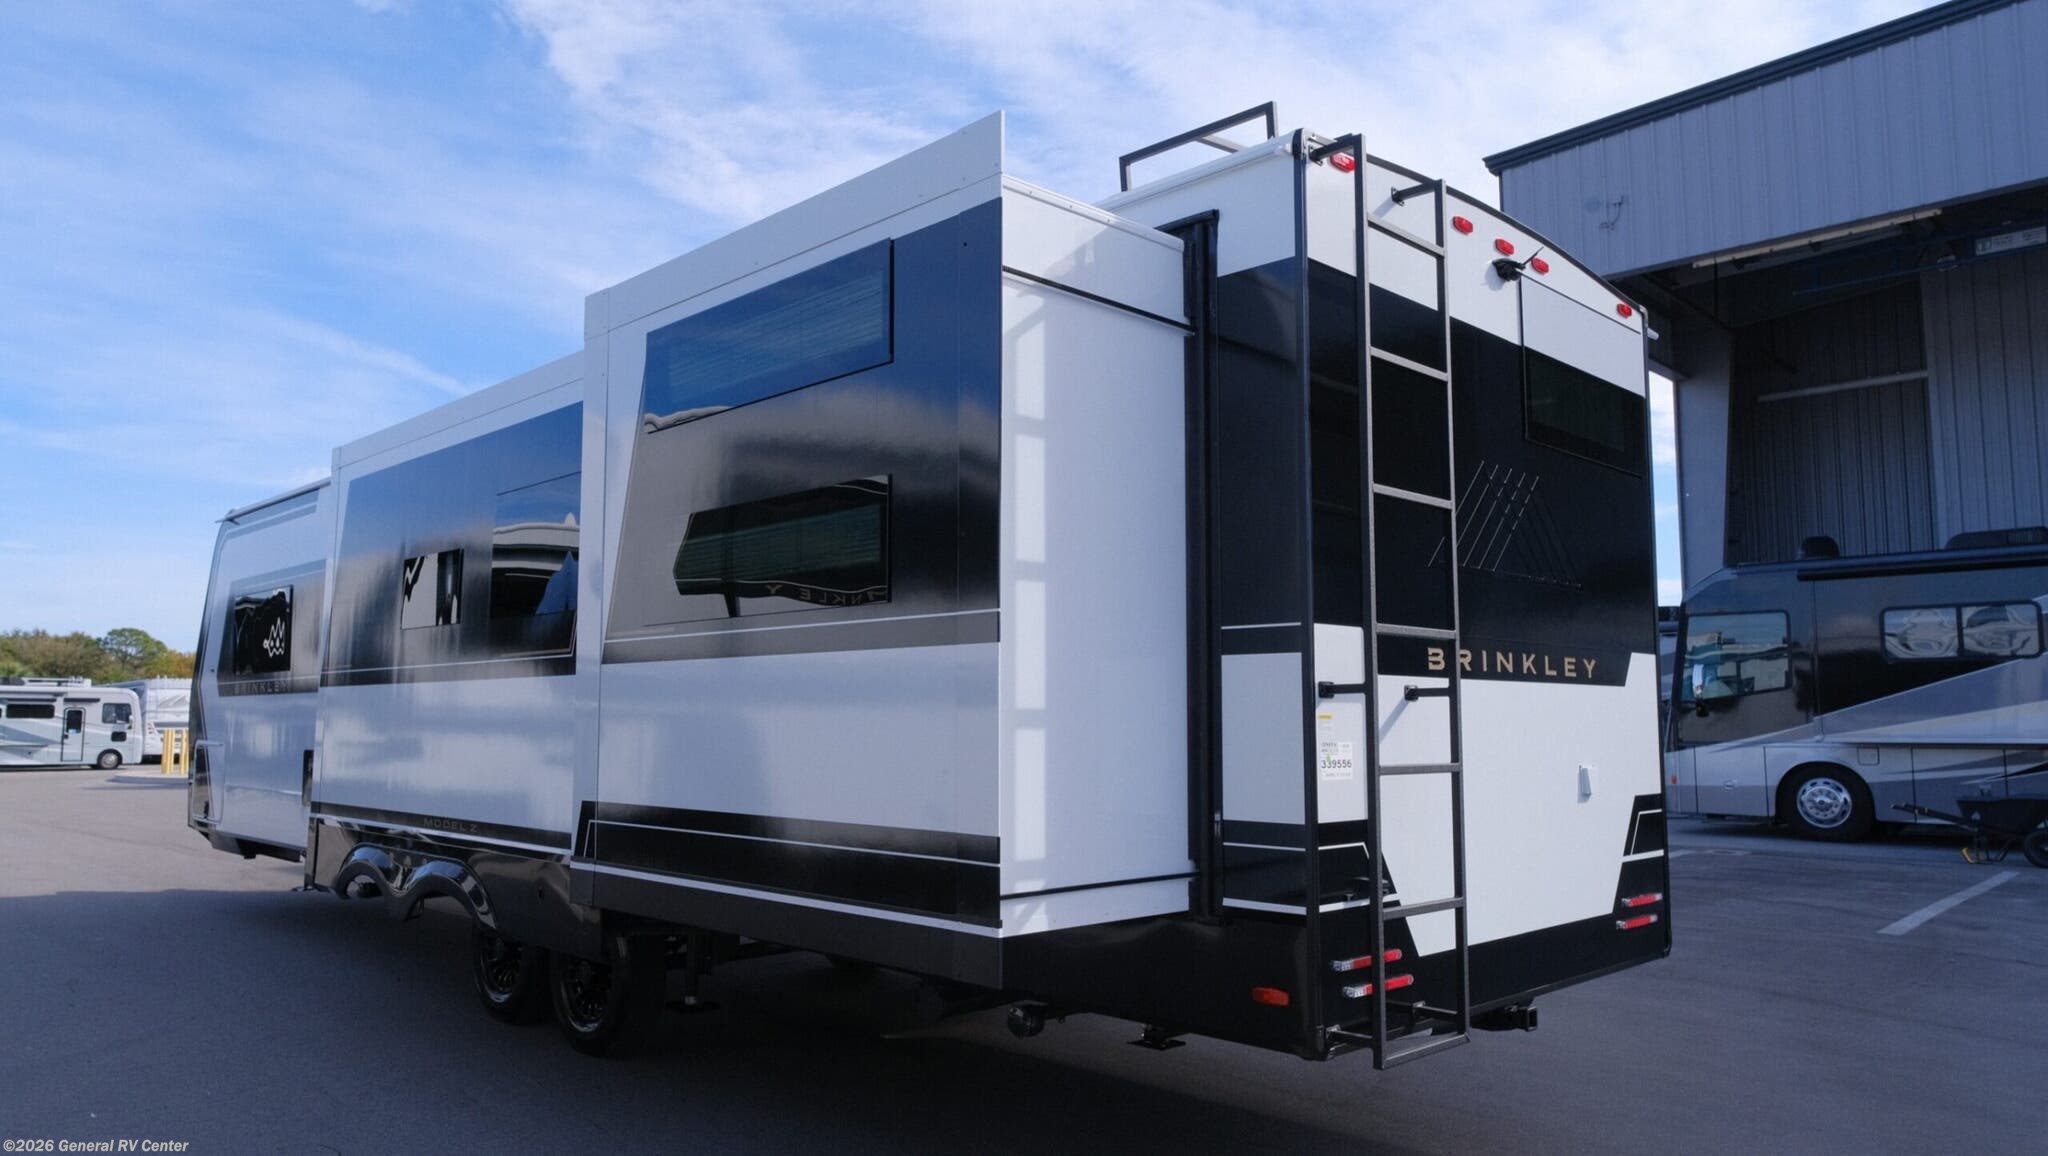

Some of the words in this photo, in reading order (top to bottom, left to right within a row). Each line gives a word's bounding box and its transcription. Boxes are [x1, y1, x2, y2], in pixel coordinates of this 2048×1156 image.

[1427, 647, 1596, 679] BRINKLEY
[1320, 759, 1352, 769] 339556
[423, 816, 466, 831] MODEL
[469, 823, 479, 833] Z
